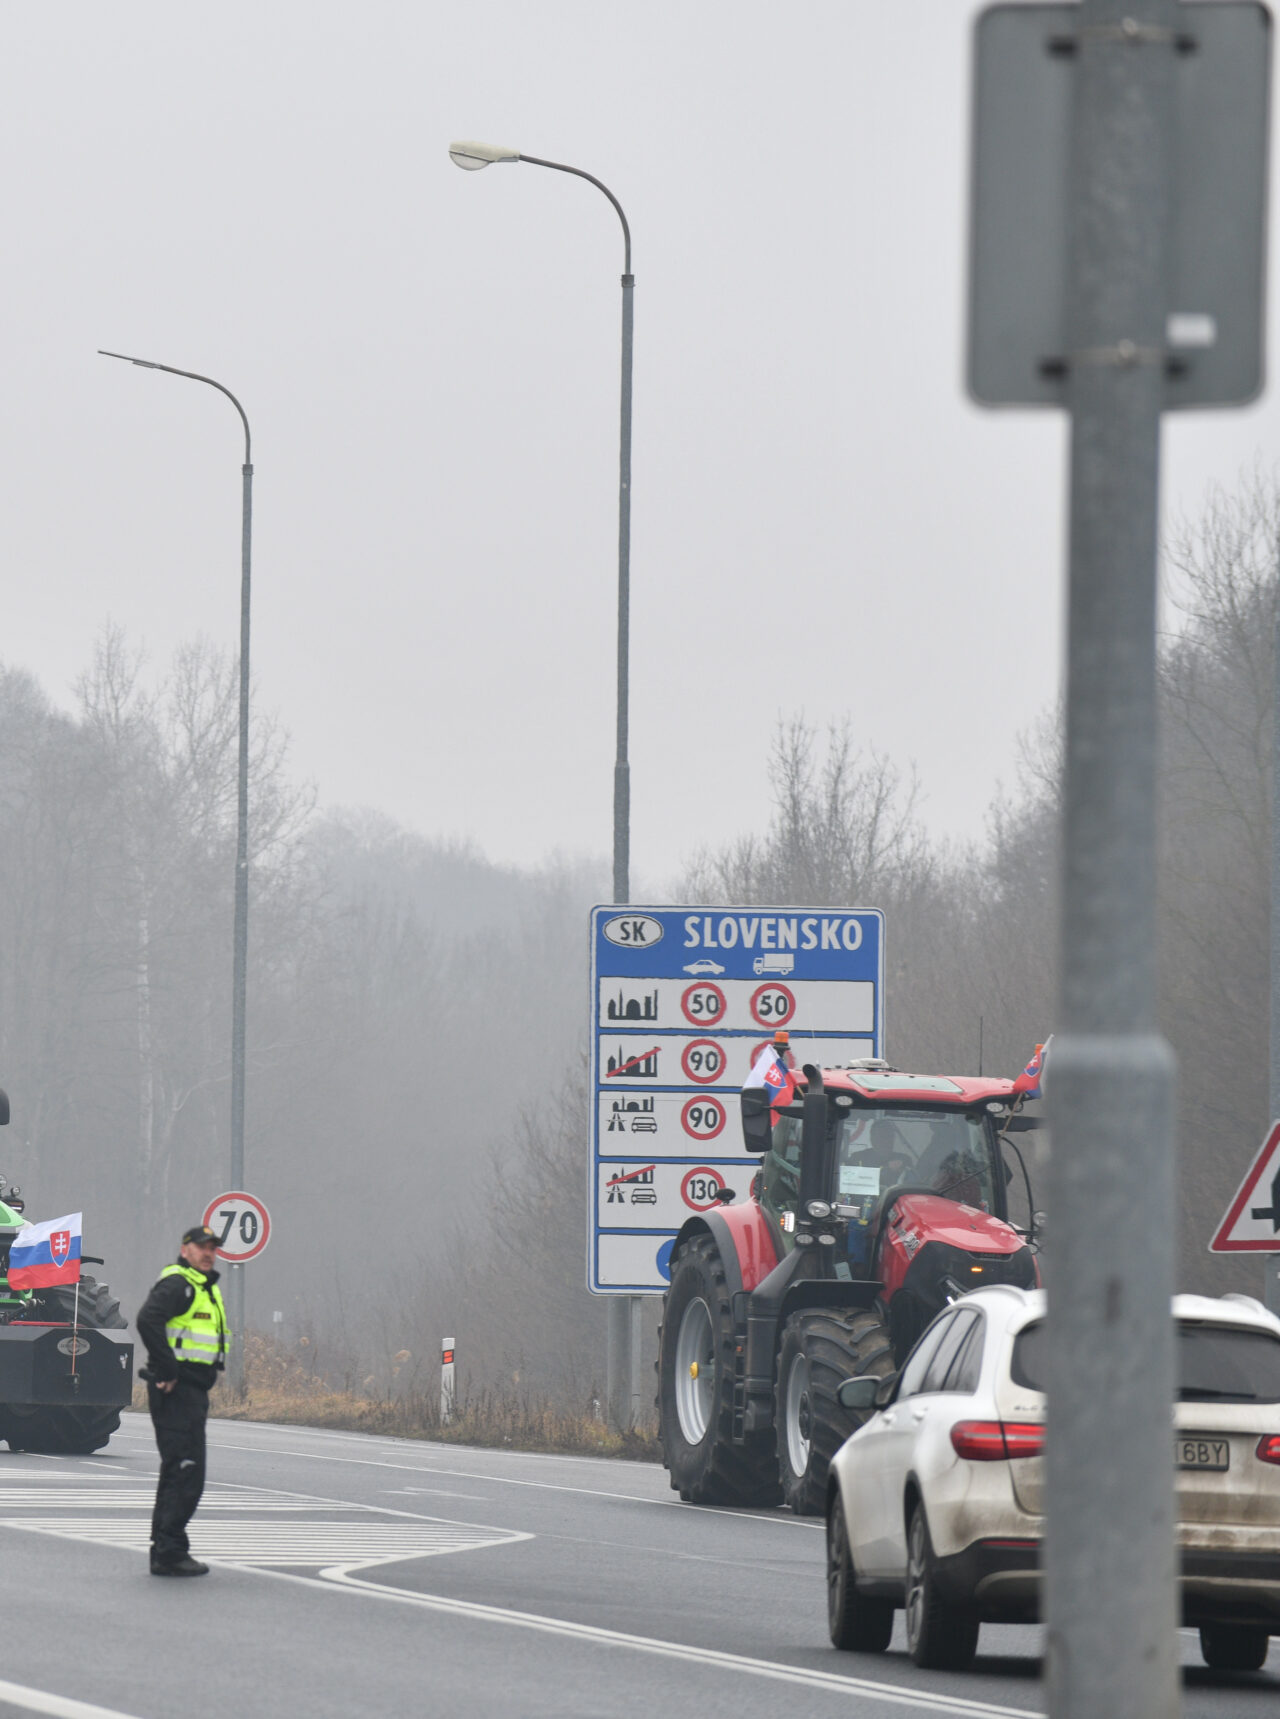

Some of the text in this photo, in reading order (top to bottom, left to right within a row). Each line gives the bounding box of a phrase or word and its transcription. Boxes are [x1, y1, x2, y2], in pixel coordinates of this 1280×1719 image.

[620, 921, 646, 942] SK
[684, 916, 863, 950] SLOVENSKO
[691, 994, 788, 1016] 50 50
[690, 1051, 718, 1072] 90
[689, 1107, 718, 1128] 90
[690, 1179, 718, 1200] 130
[220, 1210, 257, 1244] 70
